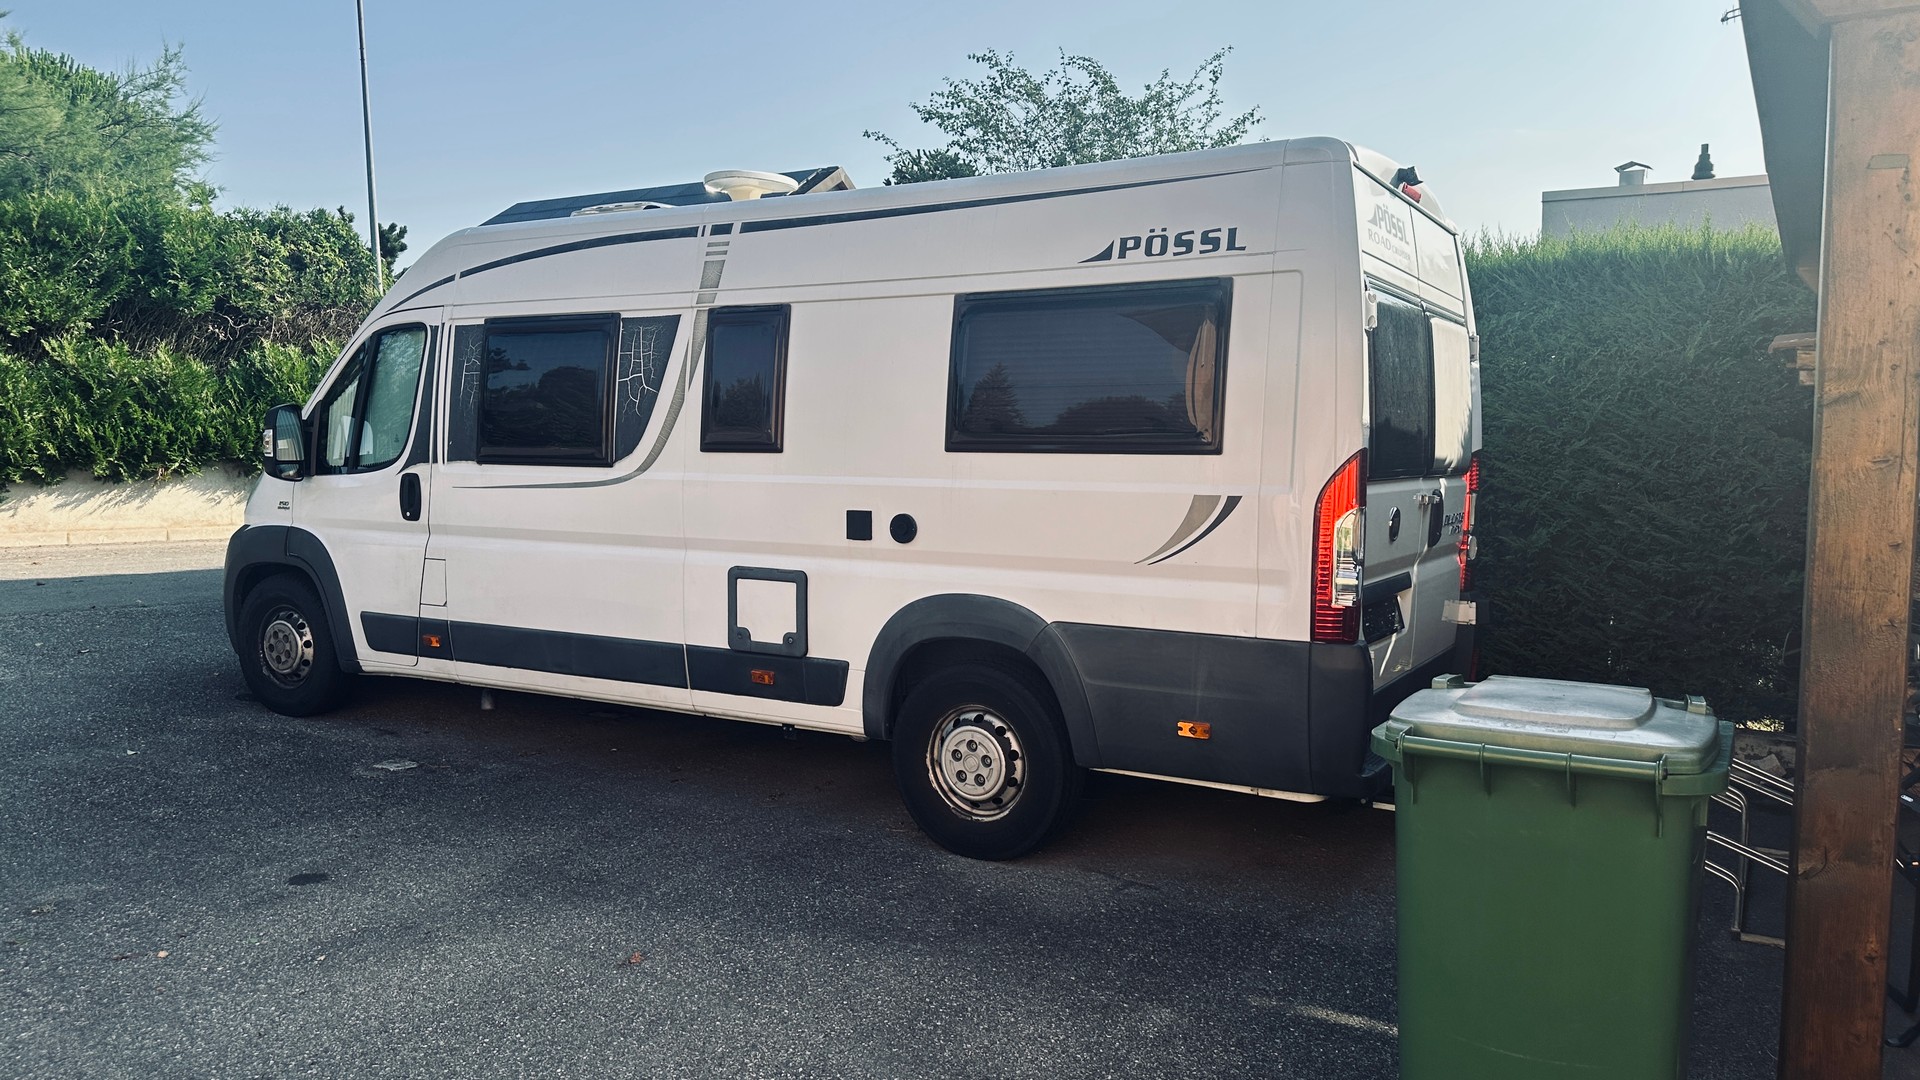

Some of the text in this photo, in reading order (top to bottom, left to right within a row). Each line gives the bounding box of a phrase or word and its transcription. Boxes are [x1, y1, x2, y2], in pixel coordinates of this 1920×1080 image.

[1367, 228, 1392, 251] ROAD
[1376, 204, 1409, 245] PÖSSL
[1117, 227, 1247, 259] PÖSSL
